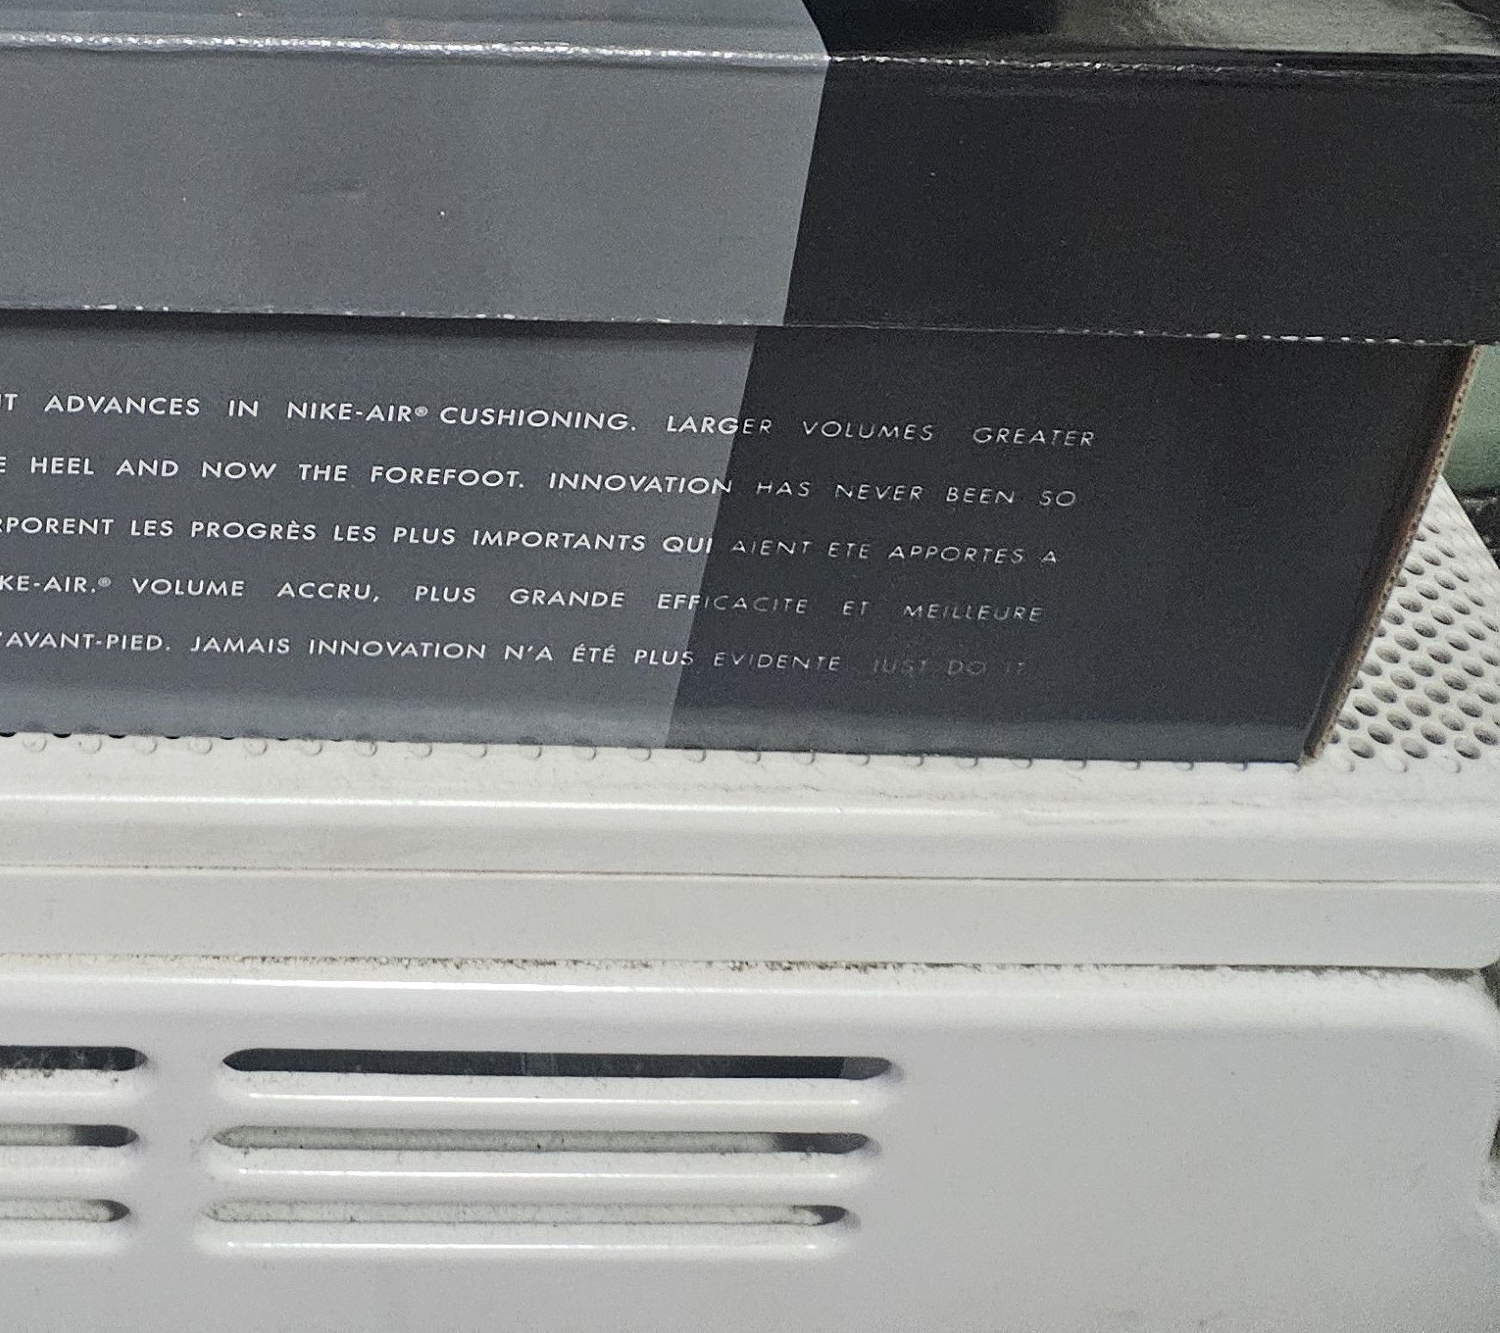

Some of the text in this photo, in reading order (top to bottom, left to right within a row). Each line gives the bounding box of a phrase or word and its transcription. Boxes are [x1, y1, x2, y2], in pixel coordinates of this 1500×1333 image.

[44, 396, 200, 416] ADVANCES
[228, 399, 259, 417] IN
[439, 406, 636, 431] CUSHIONING.
[666, 415, 774, 437] LARGER
[802, 420, 933, 442] VOLUMES
[972, 426, 1095, 447] GREATER
[30, 456, 94, 475] HEEL
[115, 459, 179, 477] AND
[201, 461, 277, 480] NOW
[298, 463, 348, 482] THE
[370, 465, 524, 488] FOREFOOT.
[549, 473, 733, 495] INNOVATION
[755, 481, 811, 498] HAS
[834, 483, 924, 502] NEVER
[945, 486, 1015, 505] BEEN
[1039, 490, 1077, 507] SO
[130, 519, 173, 537] LES
[191, 520, 316, 541] PROGRÈS
[333, 524, 376, 543] LES
[393, 526, 456, 546] PLUS
[472, 529, 646, 552] IMPORTANTS
[662, 534, 714, 555] QUI
[731, 539, 812, 556] AIENT
[132, 577, 245, 597] VOLUME
[276, 582, 379, 603] ACCRU,
[414, 585, 476, 604] PLUS
[509, 588, 625, 608] GRANDE
[842, 600, 870, 616] ET
[903, 603, 1042, 622] MEILLEURE
[190, 636, 290, 655] JAMAIS
[308, 639, 486, 659] INNOVATION
[572, 643, 616, 664] ÉTÉ
[634, 647, 695, 667] PLUS
[946, 658, 987, 677] DO
